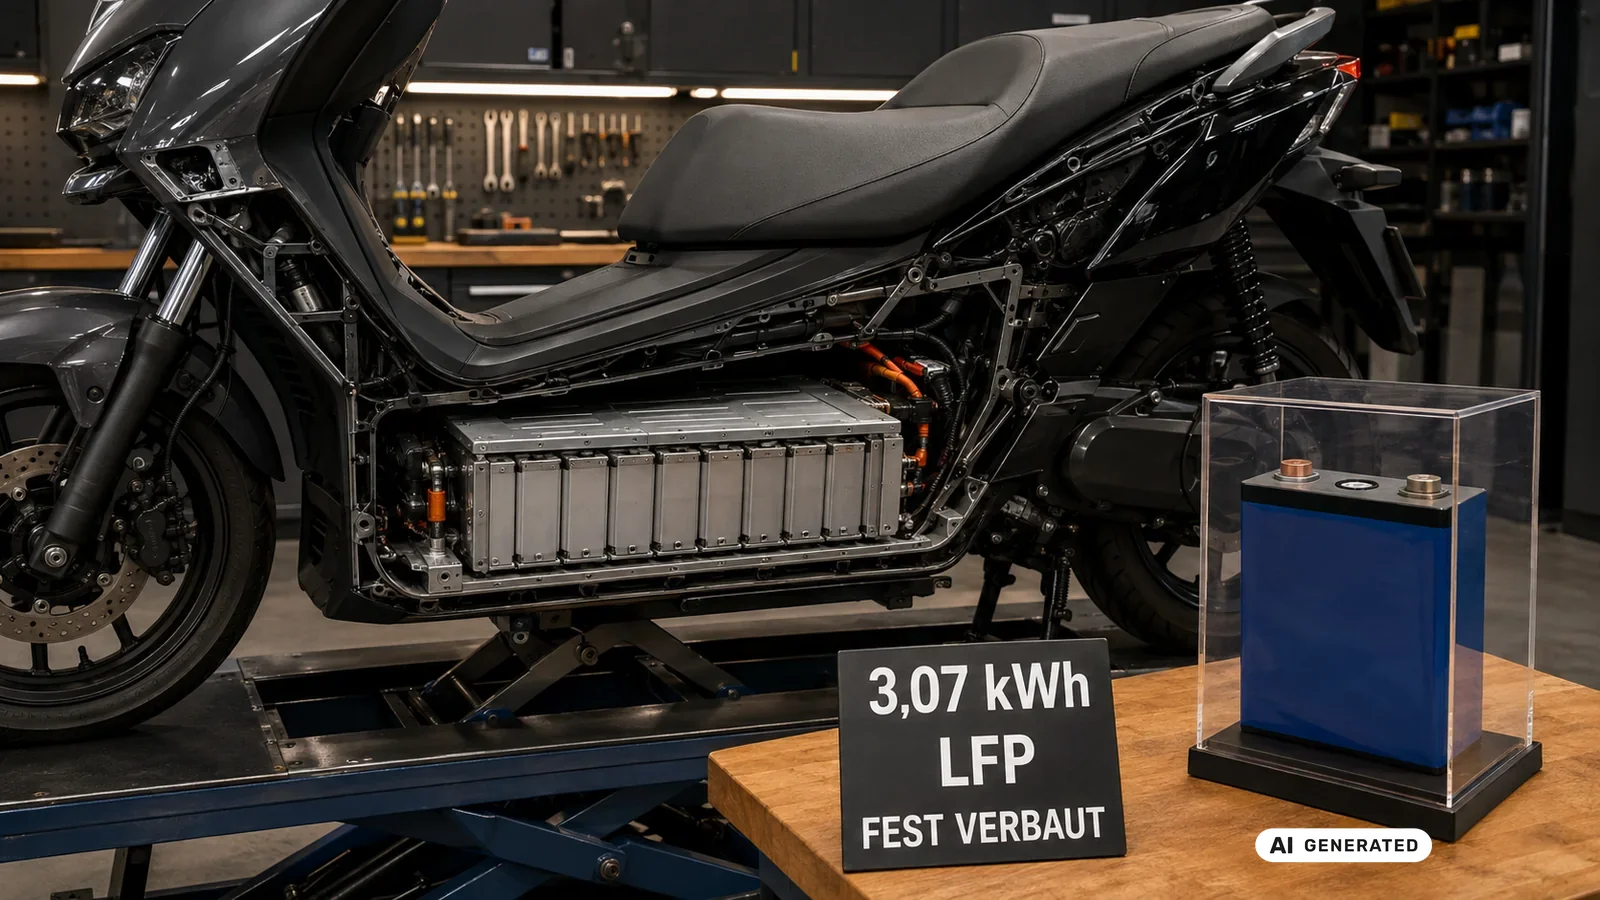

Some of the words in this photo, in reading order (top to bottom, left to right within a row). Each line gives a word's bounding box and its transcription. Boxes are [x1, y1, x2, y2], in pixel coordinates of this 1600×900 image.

[868, 664, 968, 720] 3,07
[984, 660, 1091, 711] kWh
[939, 733, 1036, 787] LFP
[862, 813, 944, 850] FEST
[954, 806, 1106, 845] VERBAUT
